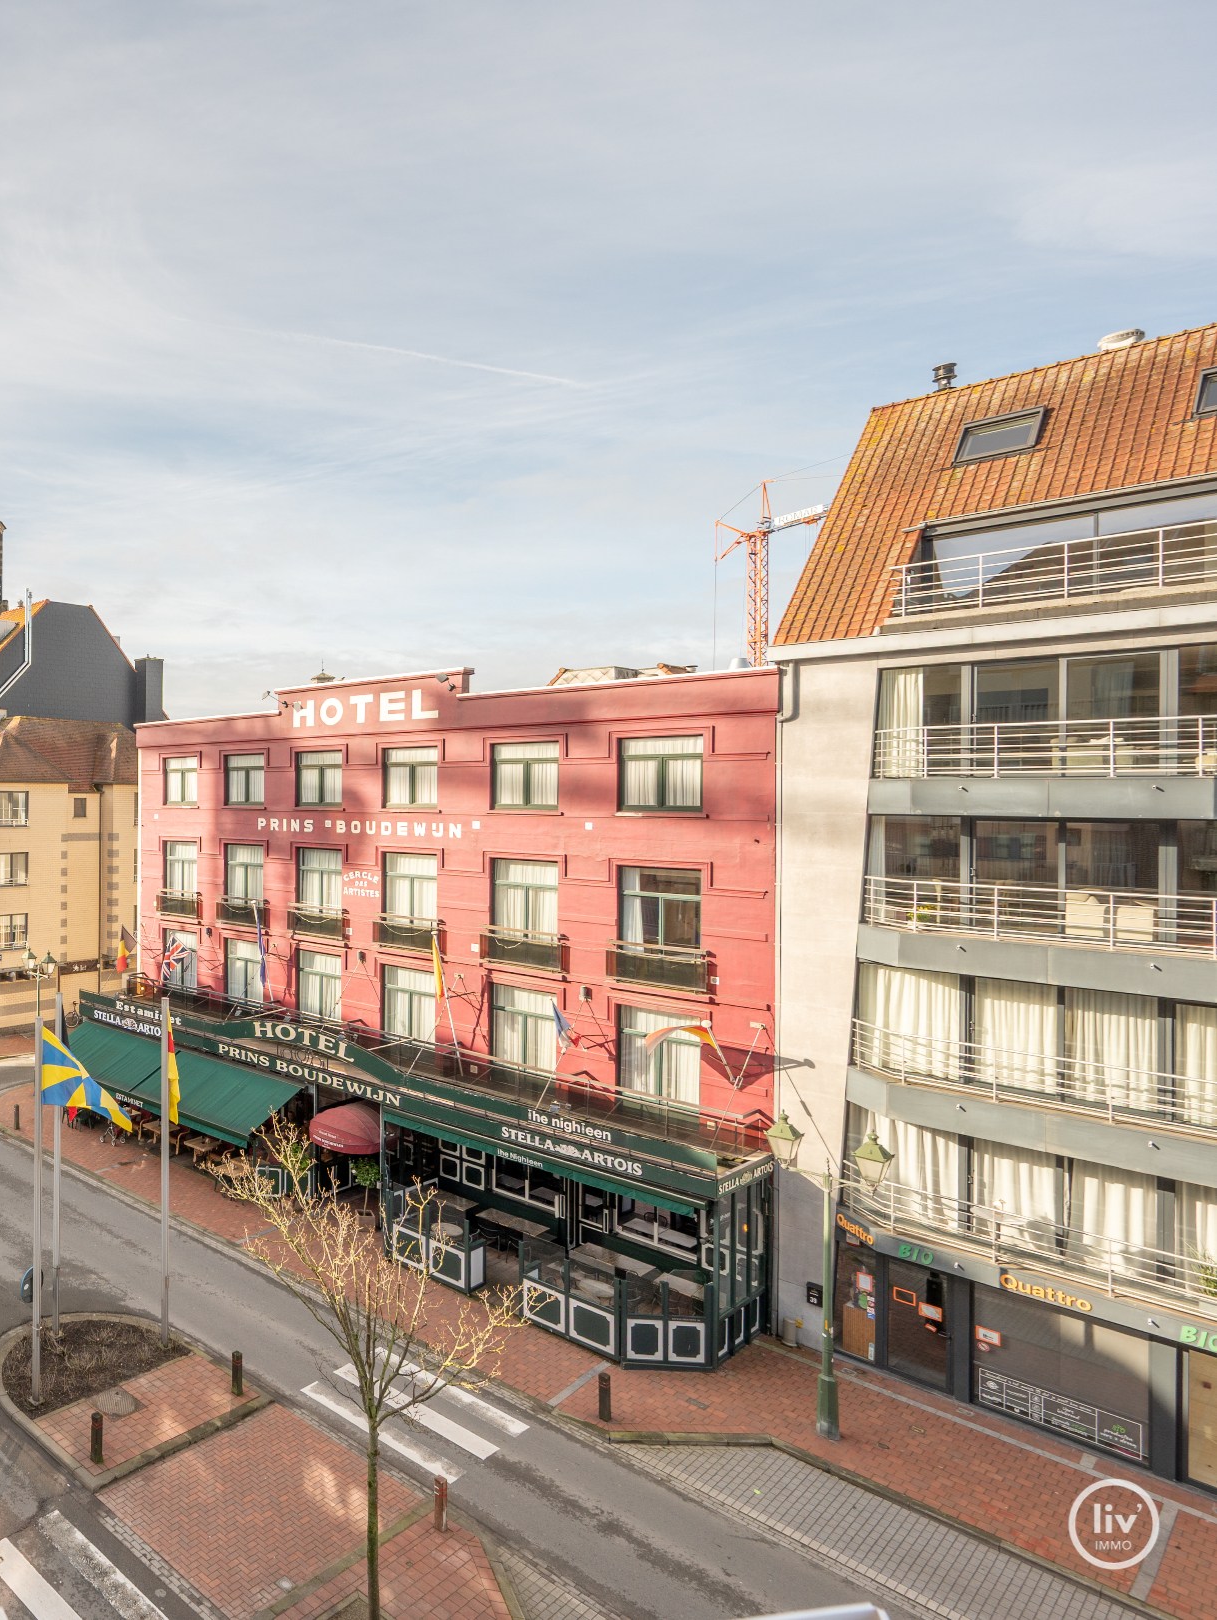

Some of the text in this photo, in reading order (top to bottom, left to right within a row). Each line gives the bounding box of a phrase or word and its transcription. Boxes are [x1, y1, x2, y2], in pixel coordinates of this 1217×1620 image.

[293, 689, 439, 728] HOTEL
[257, 817, 314, 833] PRINS
[343, 870, 379, 885] CERCLE
[343, 886, 380, 898] ARTISTES
[93, 1009, 162, 1037] STELLA ARTO
[252, 1021, 355, 1063] HOTEL
[218, 1043, 401, 1107] PRINS BOUDEWIJN
[501, 1126, 644, 1176] STELLA ARTOIS
[718, 1160, 775, 1195] STELLA ARTOIS
[836, 1213, 875, 1246] Quattro
[898, 1244, 934, 1265] BIO
[999, 1273, 1092, 1312] Quattro
